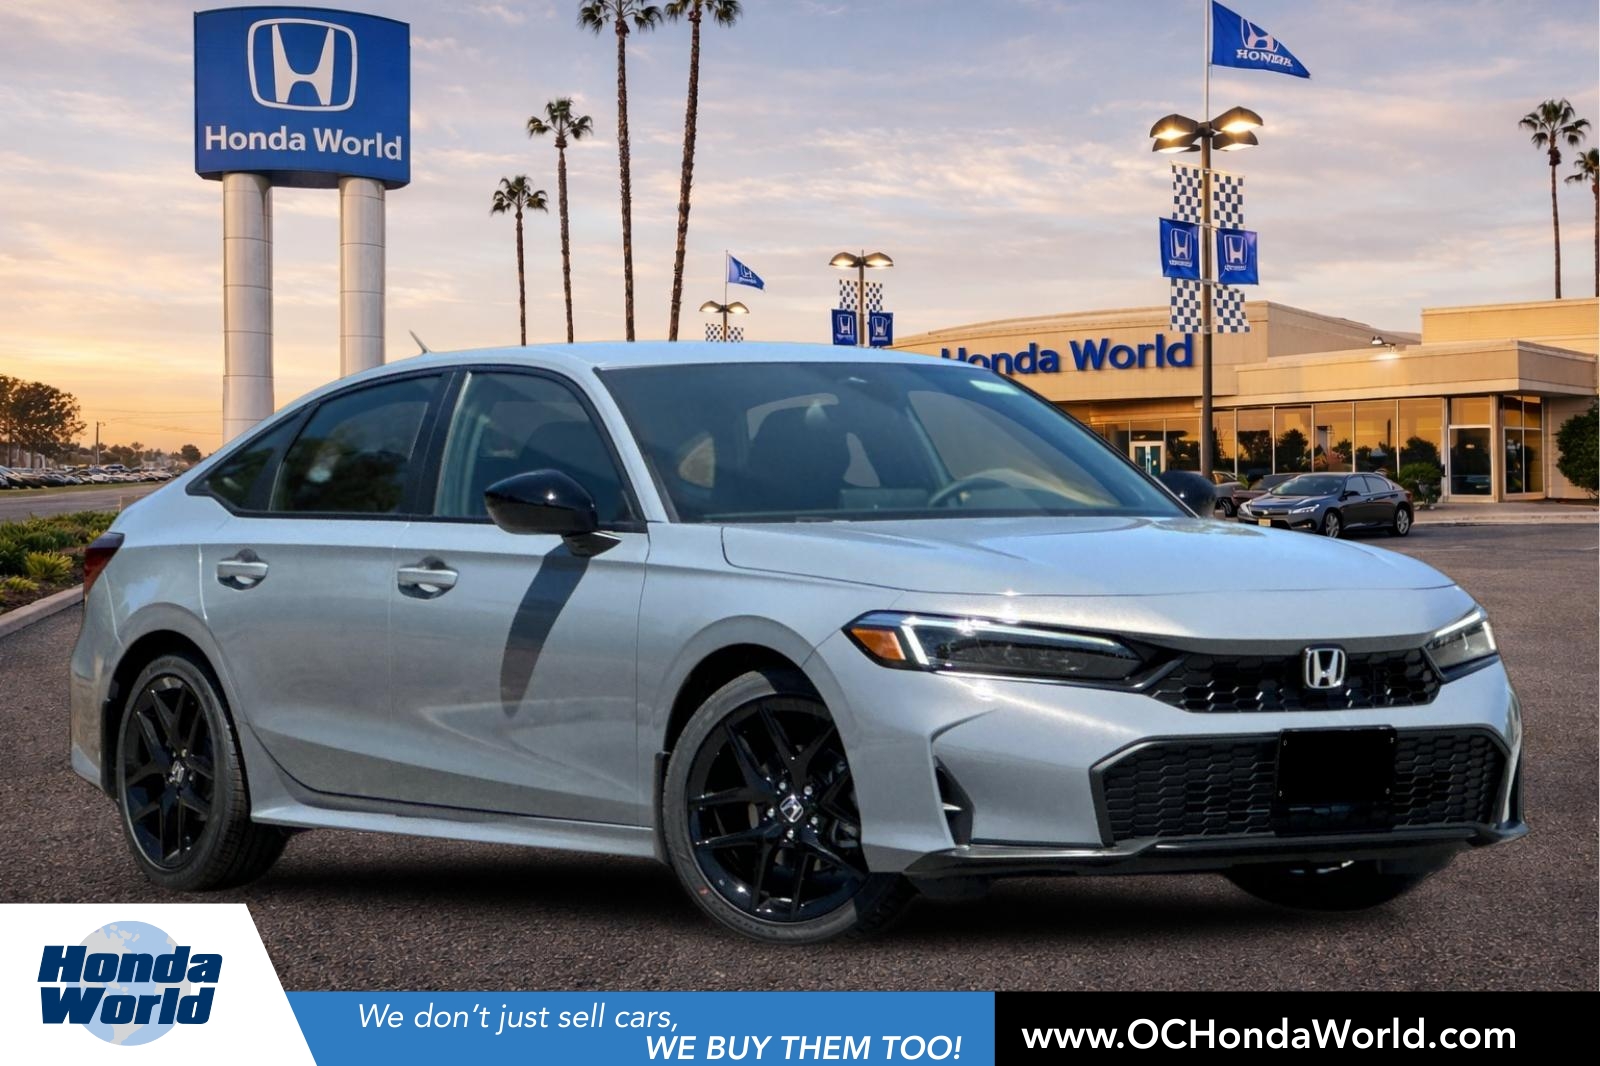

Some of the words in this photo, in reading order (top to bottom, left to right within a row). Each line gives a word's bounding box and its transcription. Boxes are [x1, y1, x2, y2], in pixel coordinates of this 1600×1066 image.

[205, 125, 306, 151] Honda
[313, 127, 402, 160] World
[1069, 333, 1194, 371] World
